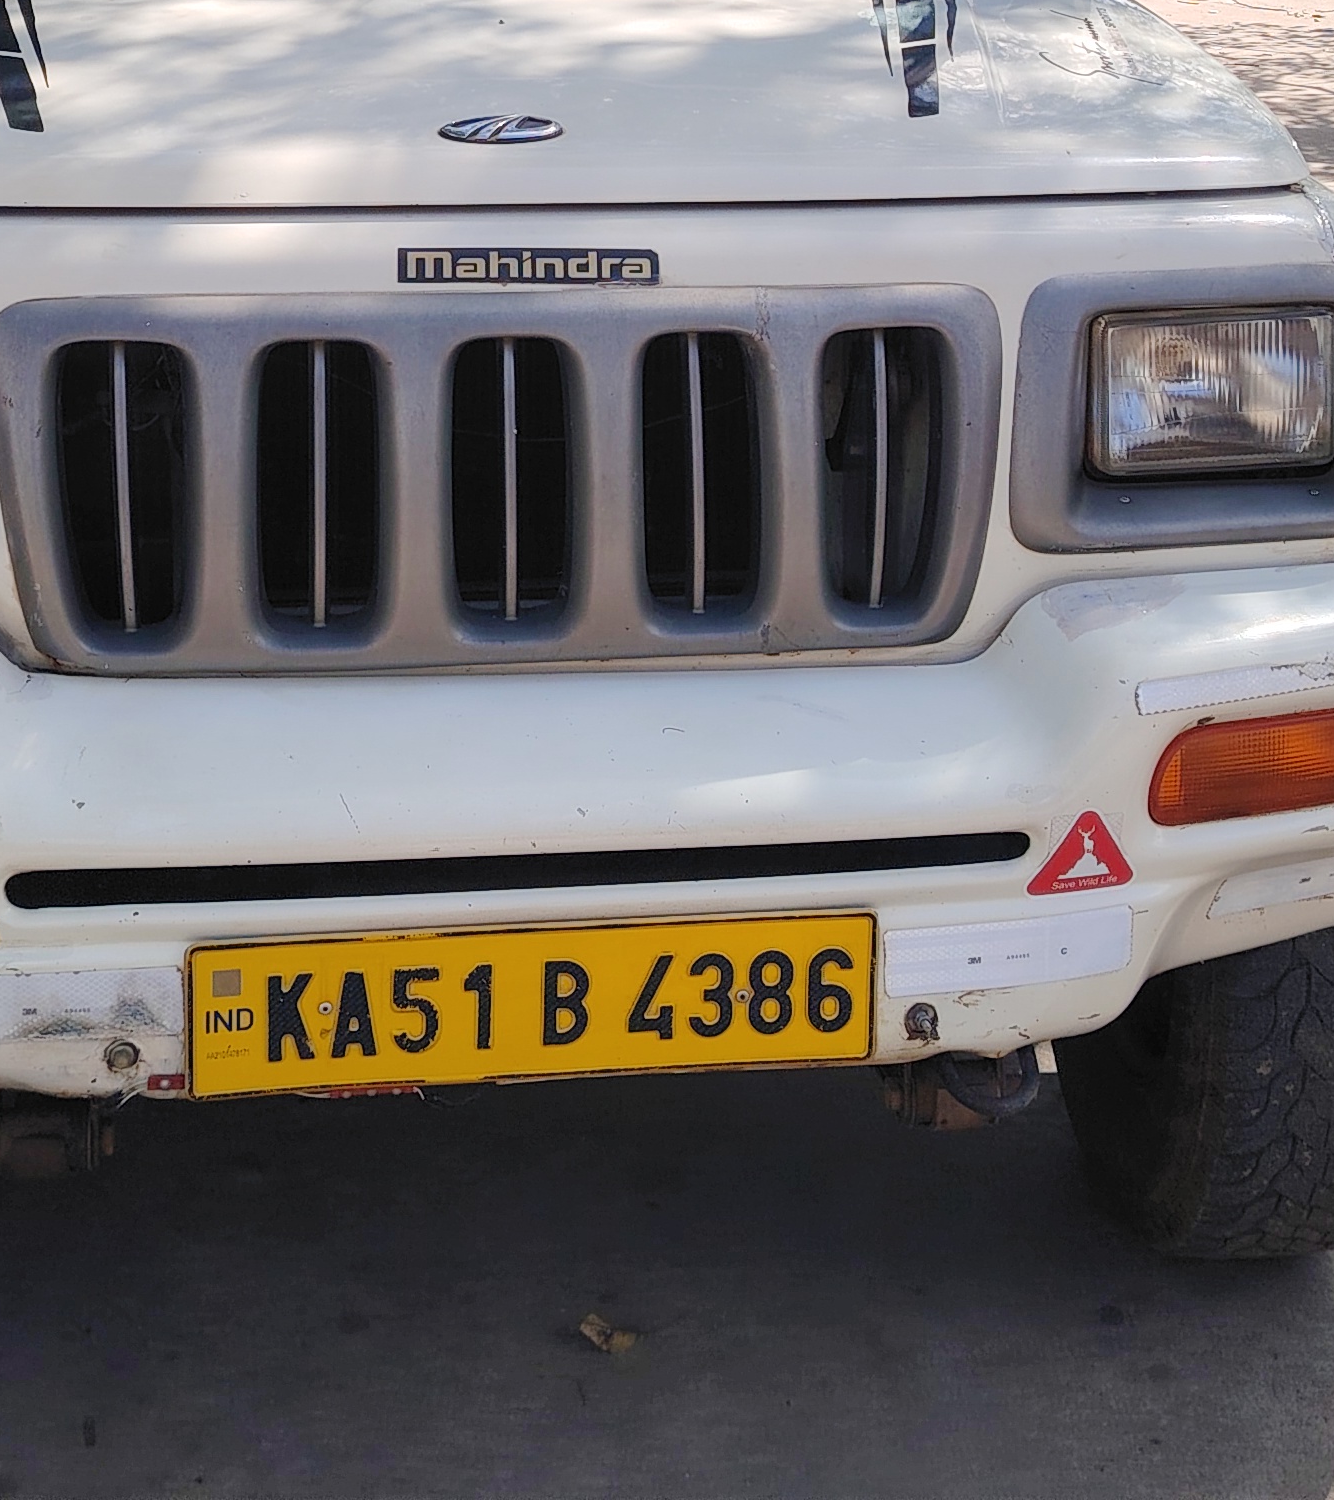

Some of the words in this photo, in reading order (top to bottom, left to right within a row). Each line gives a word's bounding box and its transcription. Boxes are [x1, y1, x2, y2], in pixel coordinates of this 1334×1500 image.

[406, 250, 653, 280] Mahindra
[1051, 880, 1076, 891] Save
[1078, 877, 1099, 887] Wild
[1101, 875, 1118, 884] Life
[967, 956, 982, 965] 3M
[1060, 947, 1068, 955] C
[267, 963, 494, 1063] KA51
[542, 960, 590, 1046] B
[627, 949, 855, 1040] 4386
[205, 1007, 254, 1034] IND
